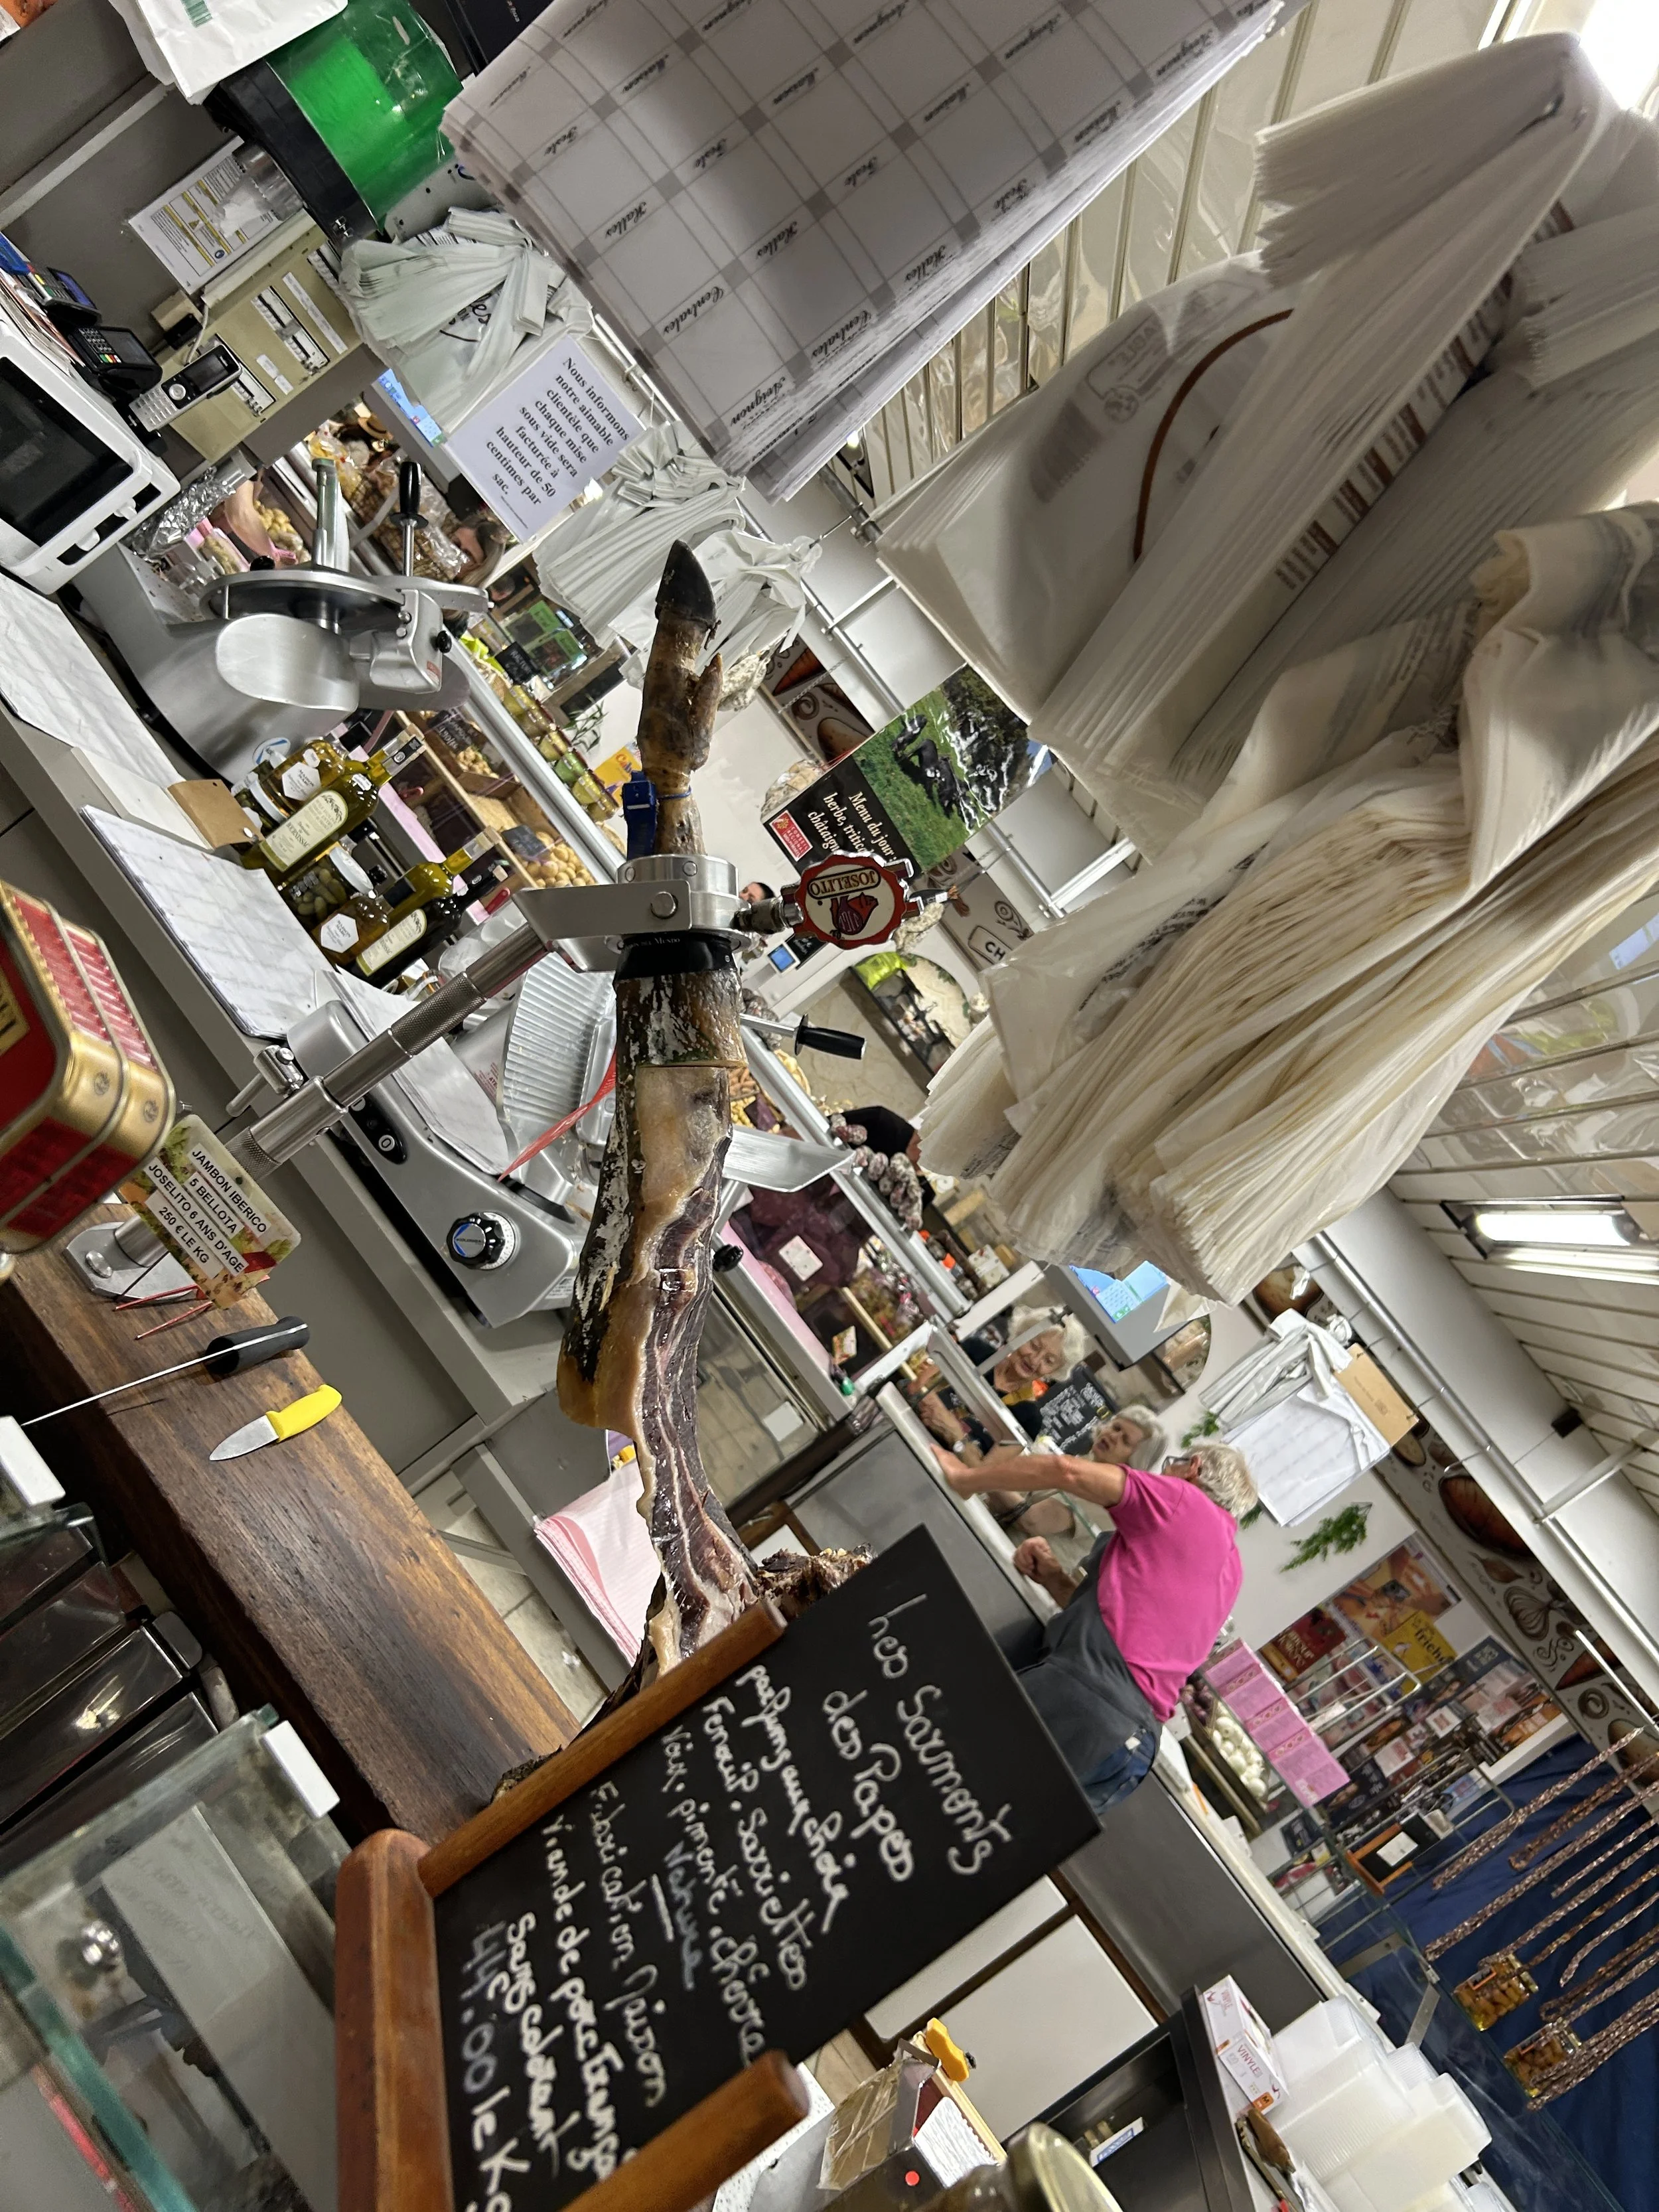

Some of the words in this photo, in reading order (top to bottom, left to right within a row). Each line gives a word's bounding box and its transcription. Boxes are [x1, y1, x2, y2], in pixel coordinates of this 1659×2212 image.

[606, 202, 646, 237] Halles
[758, 222, 797, 256] Halles
[664, 287, 723, 332] Centrales
[547, 390, 581, 432] clientèle
[581, 433, 598, 453] que
[556, 376, 579, 404] notre
[579, 405, 613, 445] aimable
[563, 358, 585, 387] Nous
[586, 386, 628, 440] informons
[731, 377, 785, 425] Avignon
[516, 427, 551, 469] facturée
[551, 469, 559, 478] à
[522, 407, 538, 430] sous
[541, 431, 559, 453] vide
[561, 455, 577, 477] sera
[536, 401, 566, 437] chaque
[566, 439, 586, 463] mise
[487, 442, 523, 486] centimes
[522, 486, 541, 504] par
[494, 474, 508, 494] sac.
[496, 427, 532, 468] hauteur
[531, 471, 542, 483] de
[541, 483, 555, 496] 50
[824, 792, 847, 826] herbe,
[843, 825, 873, 854] tritica
[849, 792, 872, 822] Menu
[867, 822, 882, 836] du
[789, 825, 810, 851] CONSEIL
[808, 812, 839, 854] châtaign
[871, 835, 895, 856] jour
[810, 870, 877, 896] JOSELITO
[192, 1151, 232, 1192] JAMBON
[229, 1191, 266, 1232] IBERICO
[196, 1186, 236, 1233] BELLOTA
[149, 1165, 191, 1211] JOSELITO
[195, 1220, 216, 1240] ANS
[214, 1240, 246, 1272] D'AGE
[159, 1207, 176, 1224] 250
[181, 1232, 196, 1248] LE
[193, 1246, 208, 1263] KG
[735, 1664, 792, 1772] parfums
[897, 1684, 1013, 1876] Sarments
[850, 1743, 914, 1882] Papes
[556, 1927, 591, 1976] de
[1237, 2044, 1261, 2074] VINYLE
